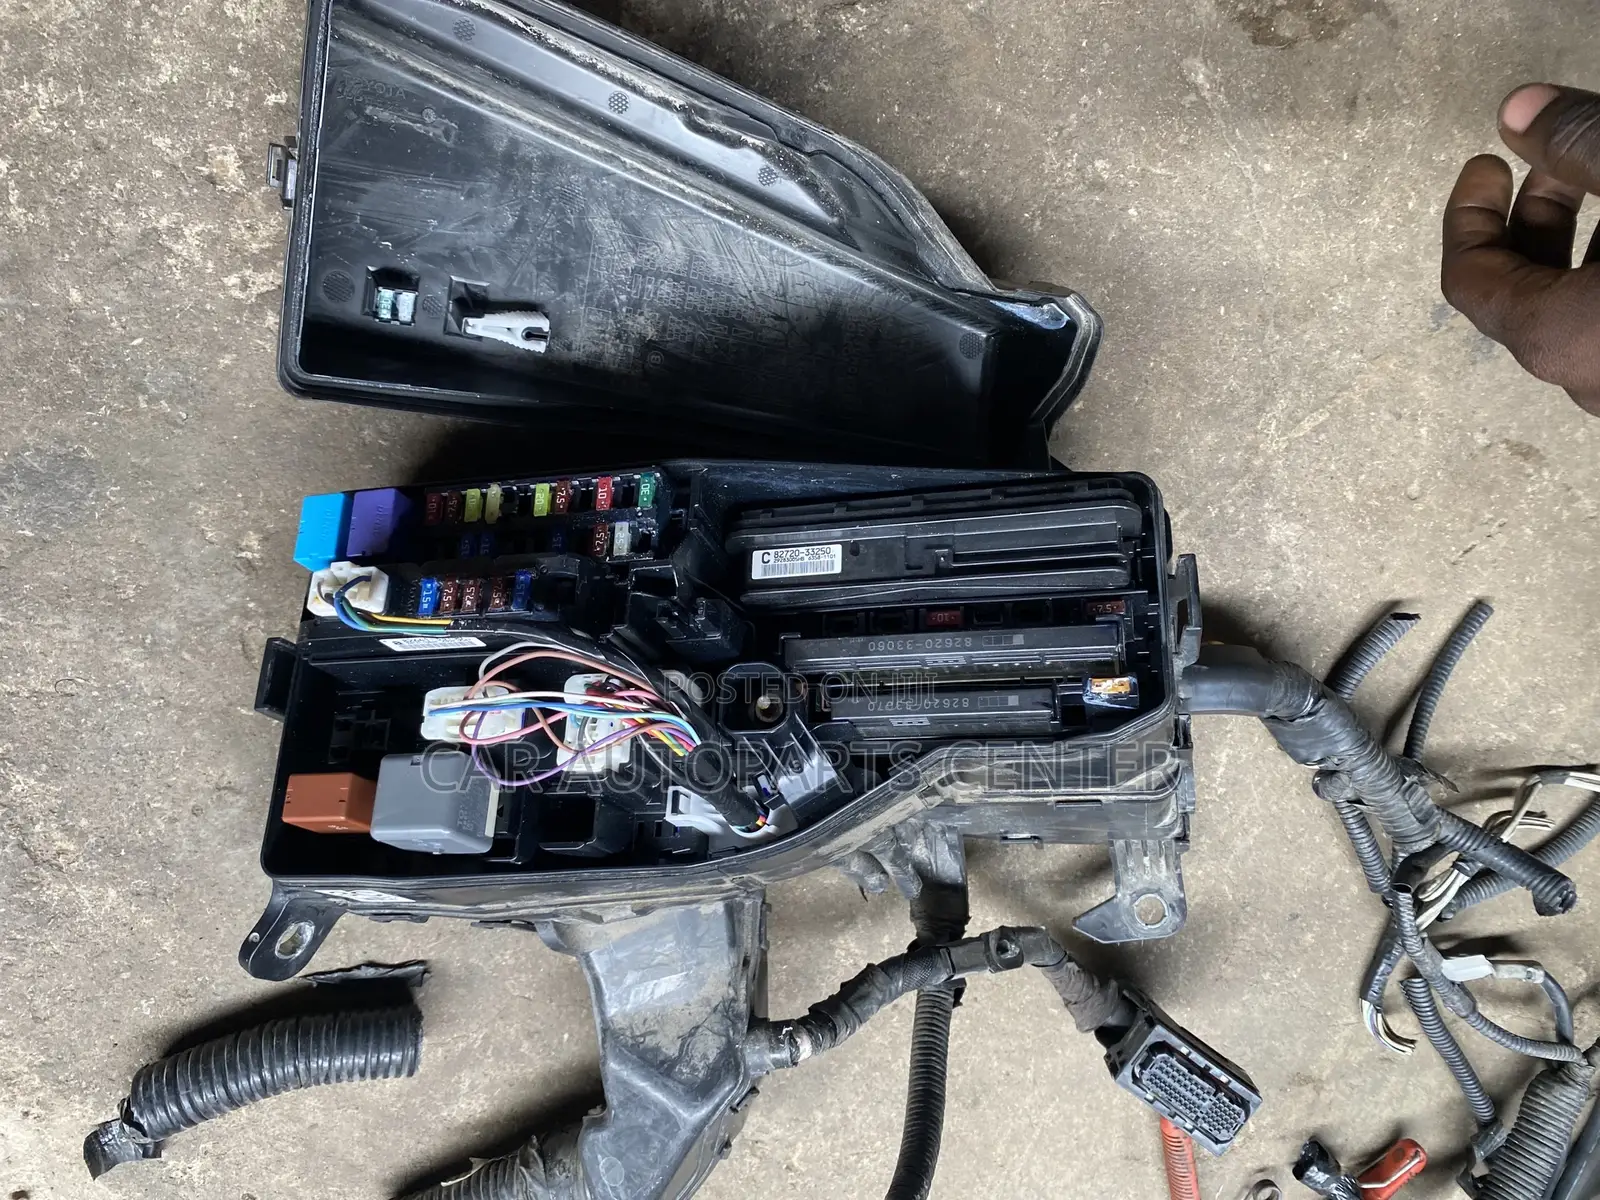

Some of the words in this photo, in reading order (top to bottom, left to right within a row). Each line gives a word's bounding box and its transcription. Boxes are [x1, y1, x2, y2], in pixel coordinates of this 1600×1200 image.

[598, 487, 607, 499] 10
[641, 483, 650, 495] 30
[535, 493, 544, 505] 20
[556, 490, 566, 504] 7.5
[595, 532, 606, 546] 7.5
[761, 552, 771, 564] C
[773, 546, 832, 559] 82720-33250
[422, 590, 432, 602] 15
[443, 587, 453, 602] 7.5
[466, 587, 475, 601] 7.5
[1096, 603, 1112, 613] 7.5
[937, 612, 949, 623] 10
[868, 636, 972, 652] 82620-33060
